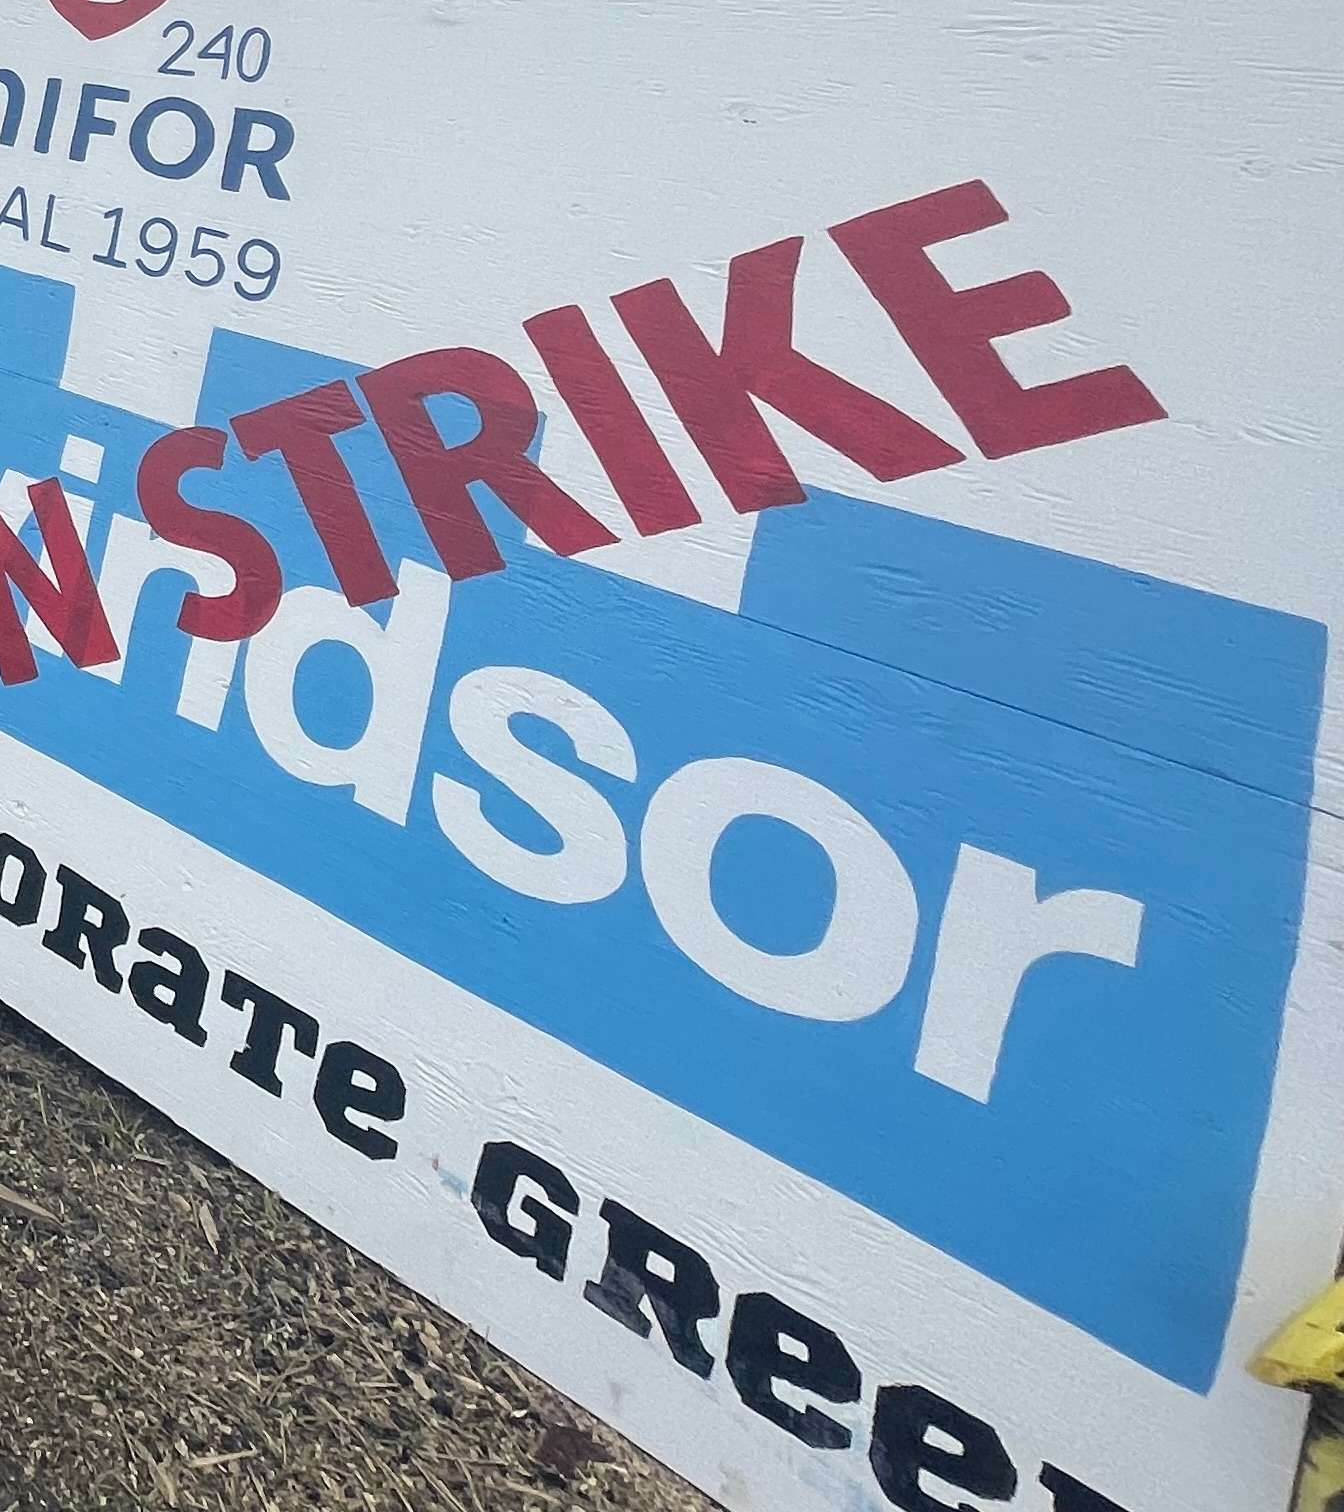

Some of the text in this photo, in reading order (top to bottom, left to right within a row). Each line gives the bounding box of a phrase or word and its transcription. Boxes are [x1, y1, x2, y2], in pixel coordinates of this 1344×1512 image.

[158, 20, 272, 84] 240
[92, 206, 282, 302] 1959
[136, 178, 1169, 643] STRIKE
